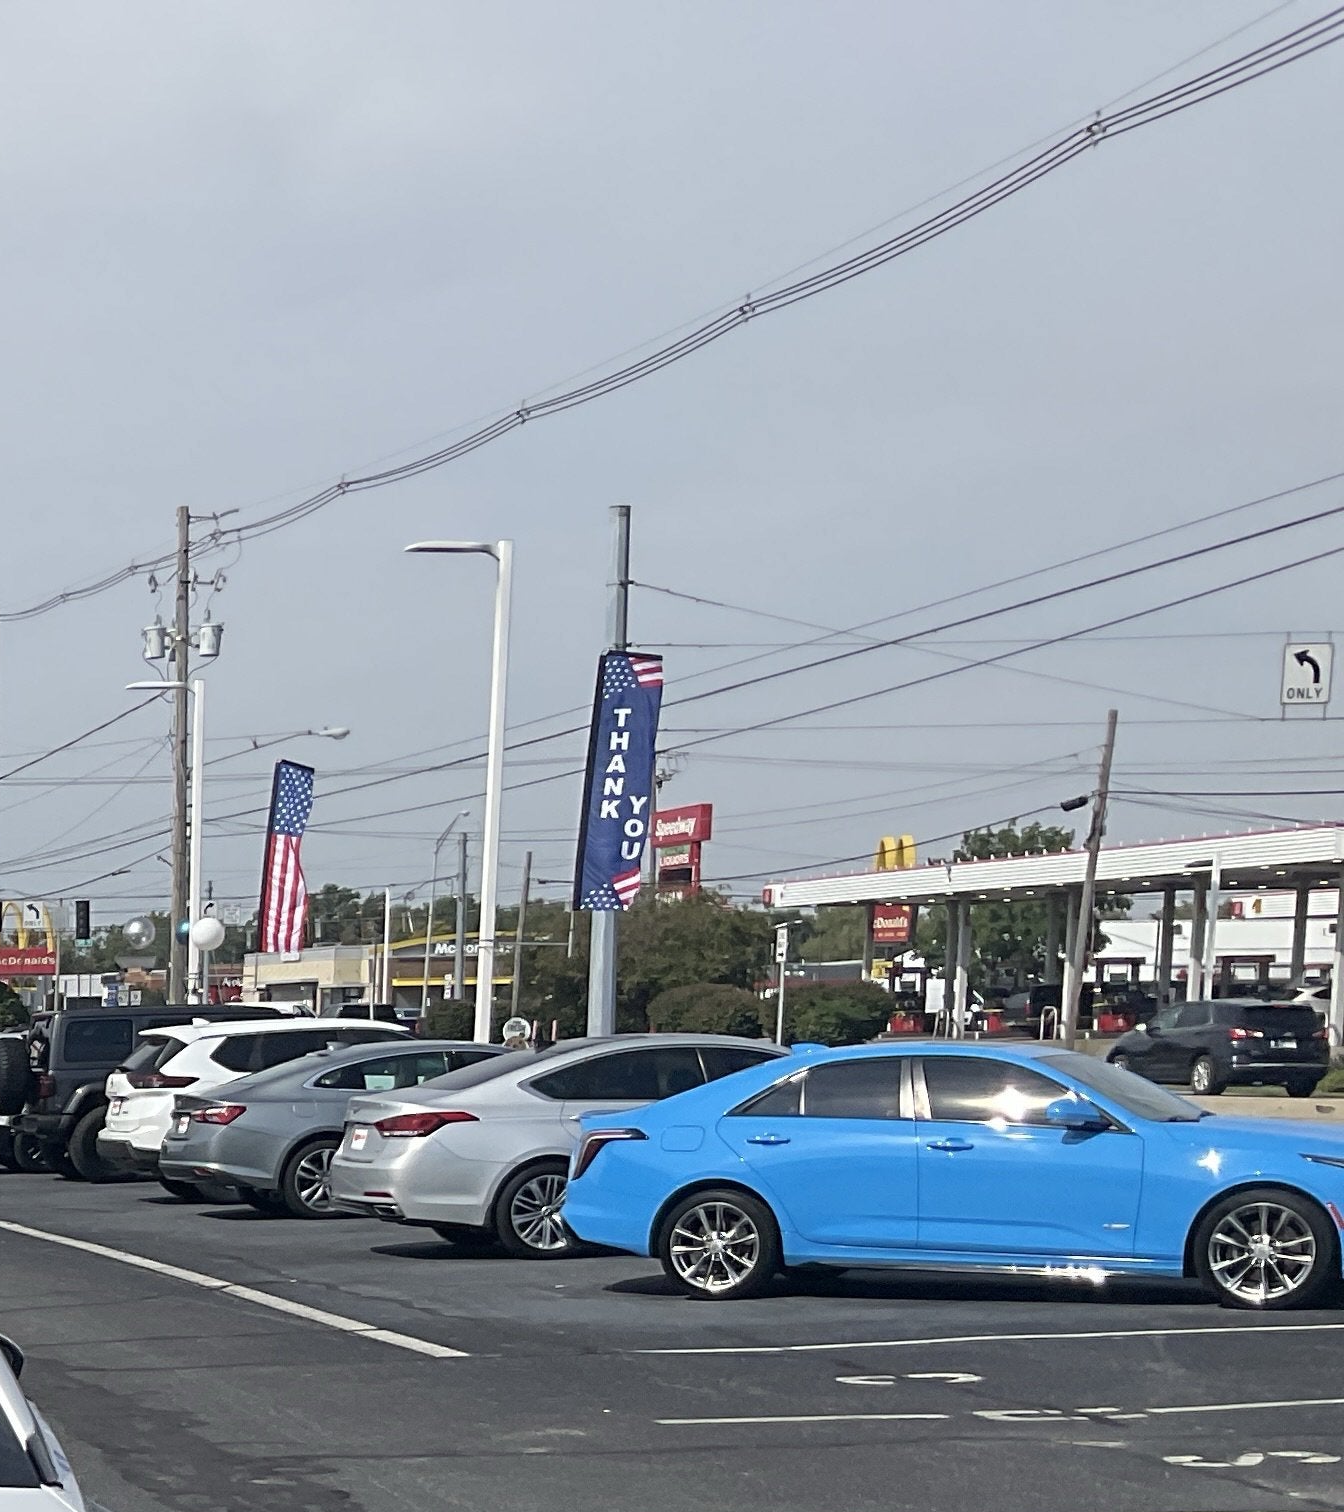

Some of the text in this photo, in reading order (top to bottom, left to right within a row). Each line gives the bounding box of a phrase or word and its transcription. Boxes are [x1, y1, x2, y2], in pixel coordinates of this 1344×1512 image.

[1286, 687, 1323, 699] ONLY
[600, 708, 648, 860] THANK YOU
